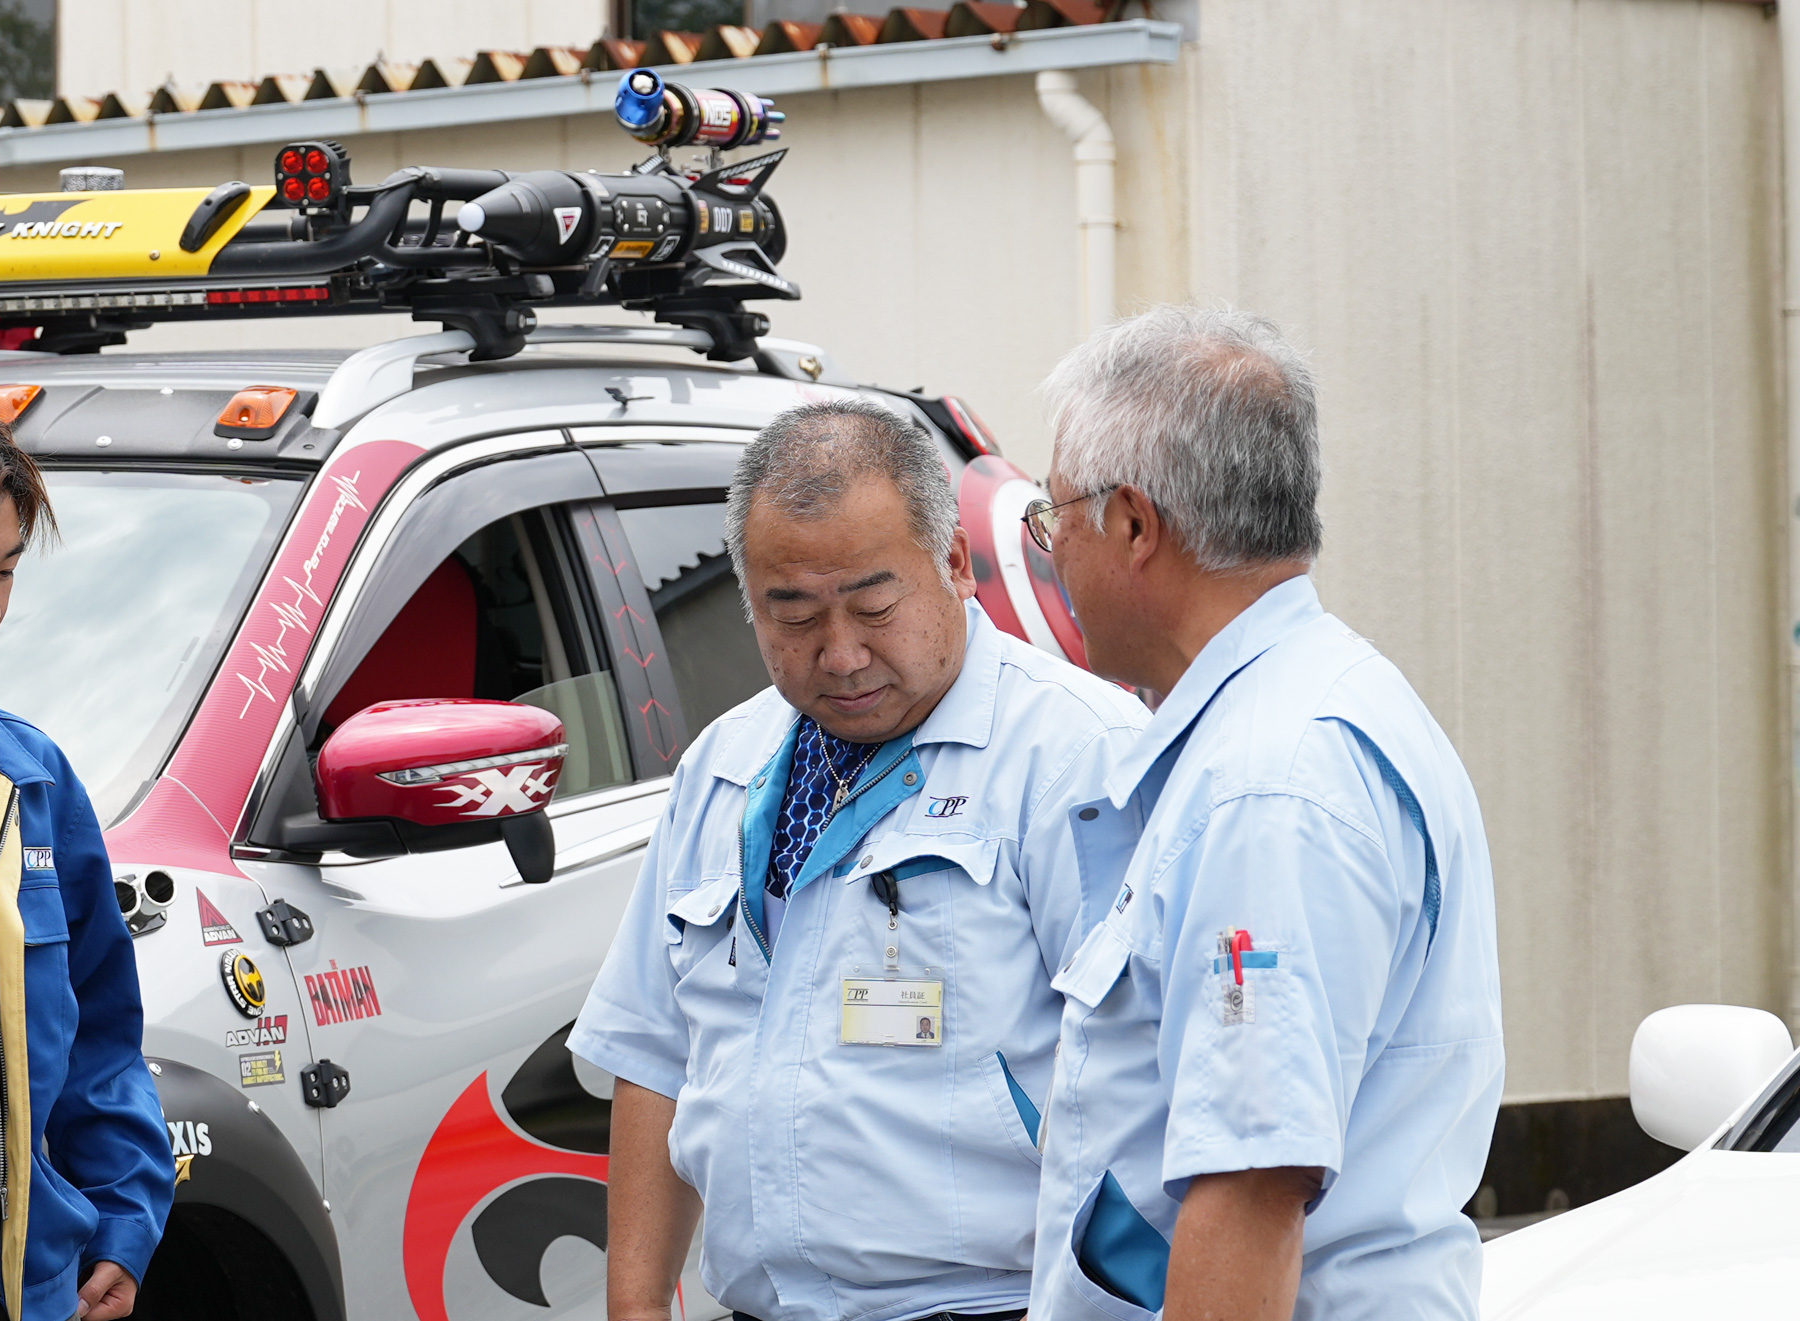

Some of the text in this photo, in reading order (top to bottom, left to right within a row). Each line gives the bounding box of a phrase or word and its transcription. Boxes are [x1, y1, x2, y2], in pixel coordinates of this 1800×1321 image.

[702, 99, 732, 126] NOS
[10, 221, 124, 239] KNIGHT
[713, 206, 733, 234] 007
[928, 796, 968, 818] CPP
[26, 849, 53, 868] CPP
[203, 929, 238, 942] ADVAN
[303, 965, 382, 1027] BATMAN
[226, 1026, 286, 1048] ADVAN
[165, 1120, 213, 1157] XIS
